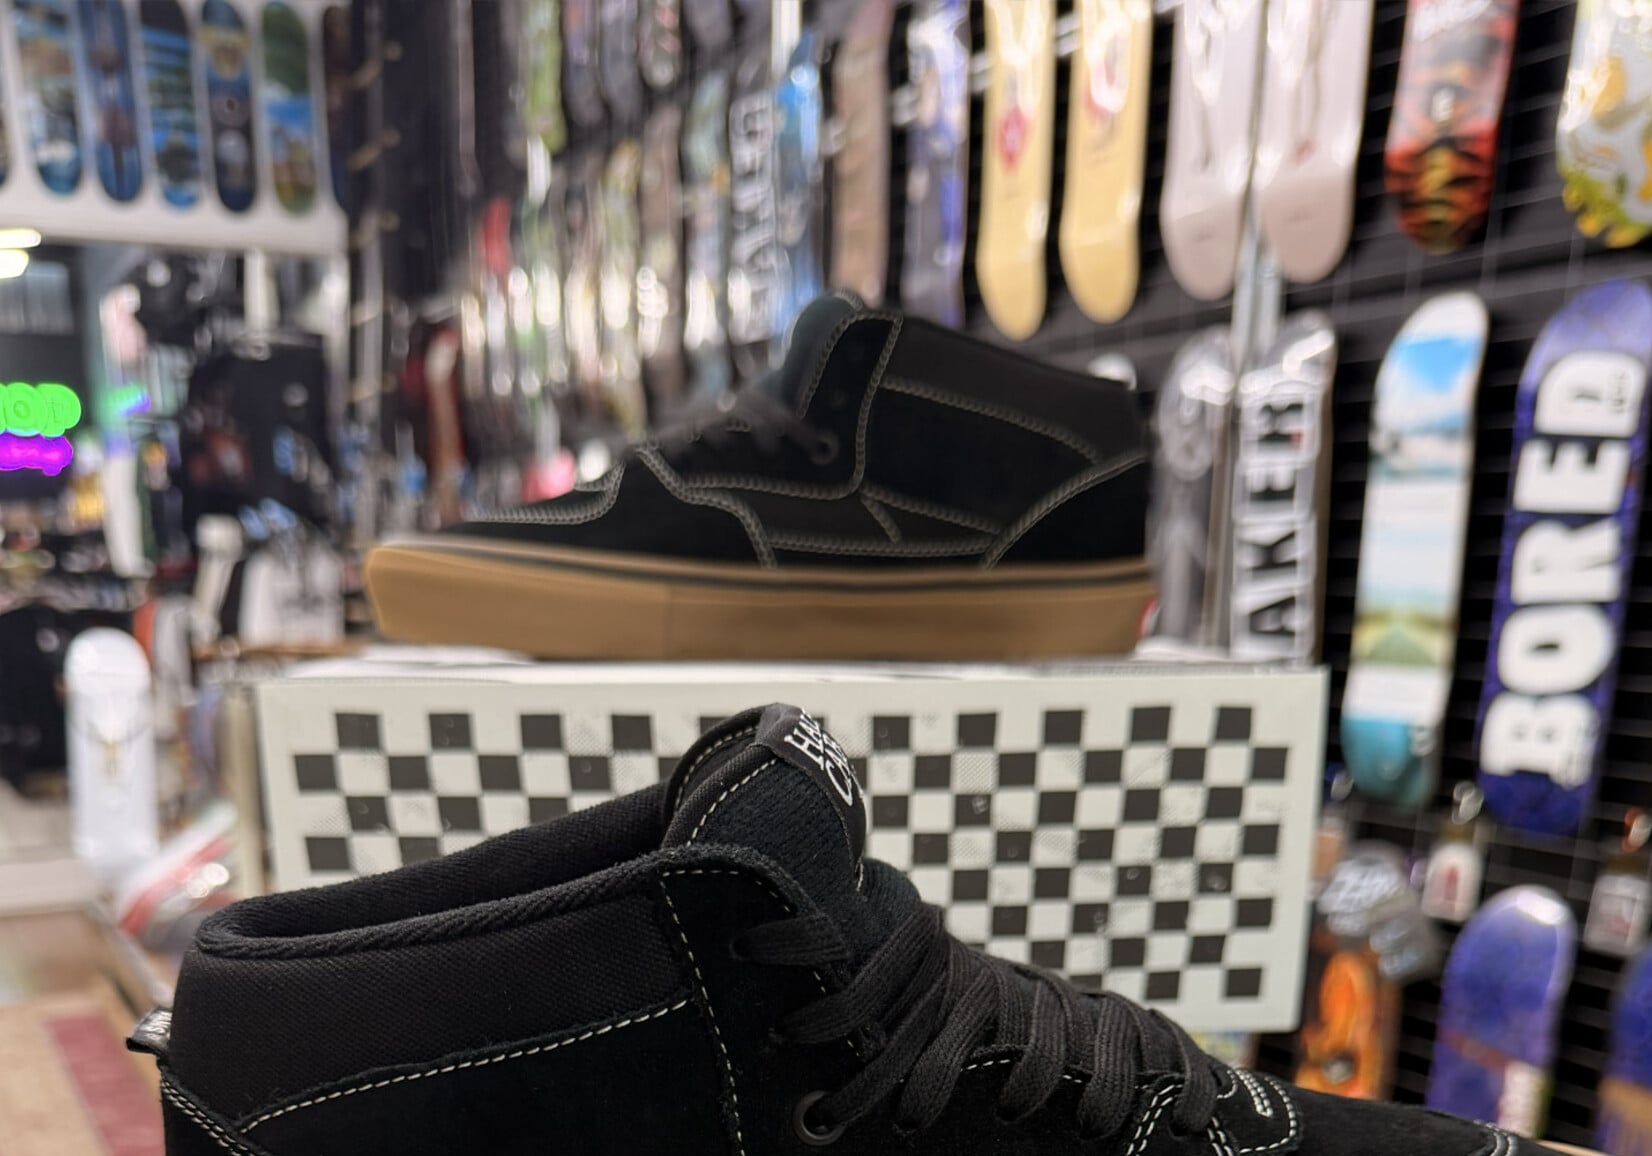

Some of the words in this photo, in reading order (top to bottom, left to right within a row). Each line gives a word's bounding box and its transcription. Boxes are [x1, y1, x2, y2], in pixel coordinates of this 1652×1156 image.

[0, 382, 81, 437] OP
[1231, 380, 1318, 662] AKER
[1480, 351, 1648, 787] BORED
